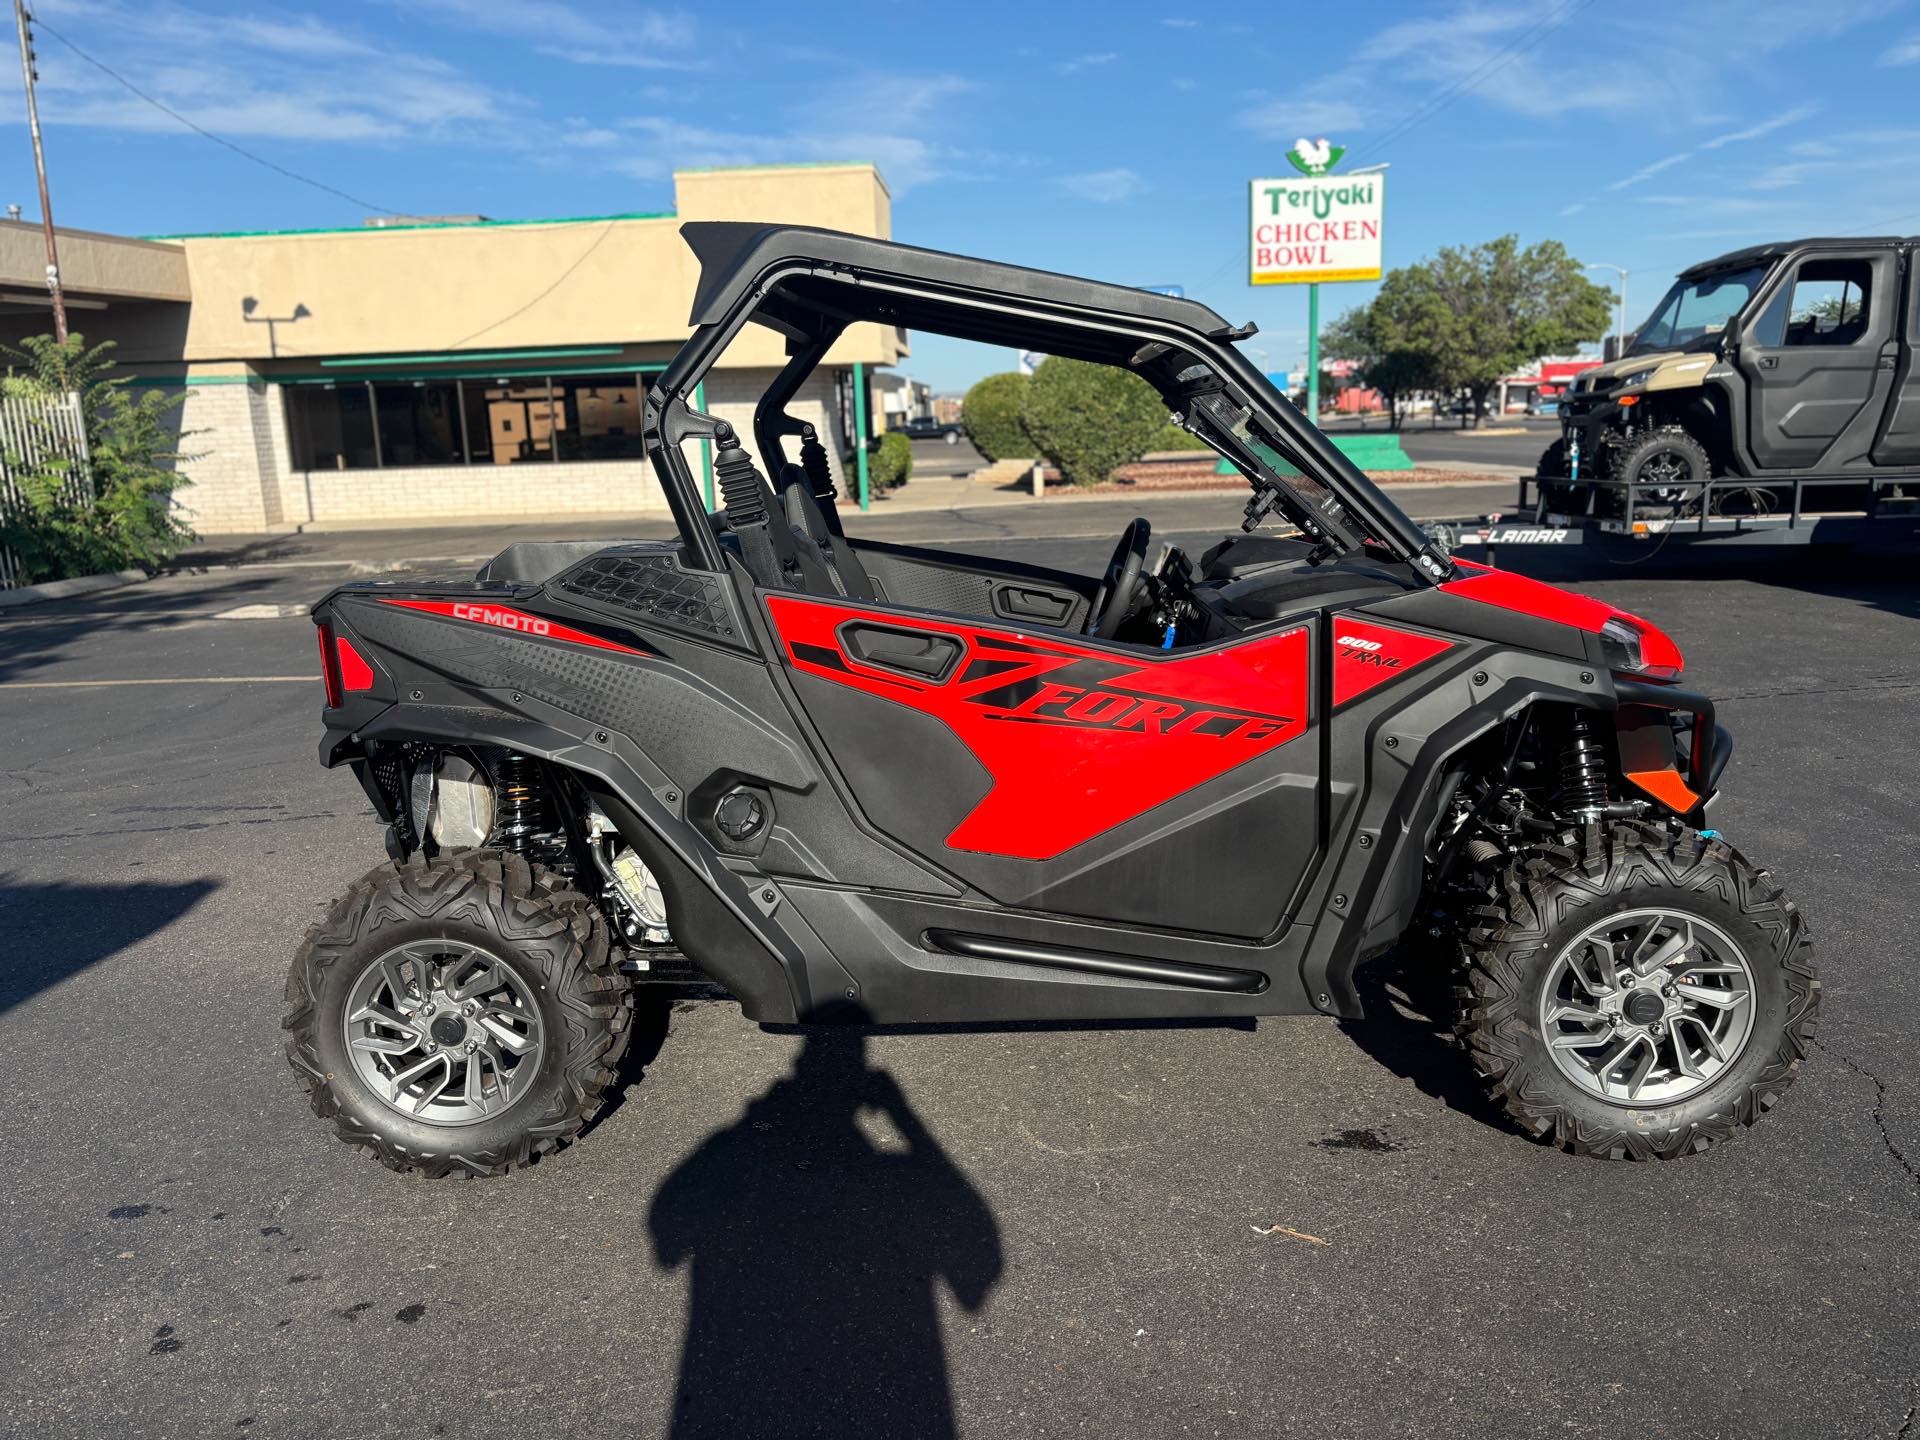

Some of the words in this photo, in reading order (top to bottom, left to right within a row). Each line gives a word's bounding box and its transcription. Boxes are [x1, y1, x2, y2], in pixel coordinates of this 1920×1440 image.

[1263, 182, 1374, 219] Teriyaki
[1256, 220, 1378, 245] CHICKEN
[1256, 244, 1333, 267] BOWL
[1486, 529, 1568, 543] LAMAR
[453, 603, 549, 635] CFMOTO
[1336, 636, 1383, 651] 800
[1341, 646, 1403, 668] TRAIL
